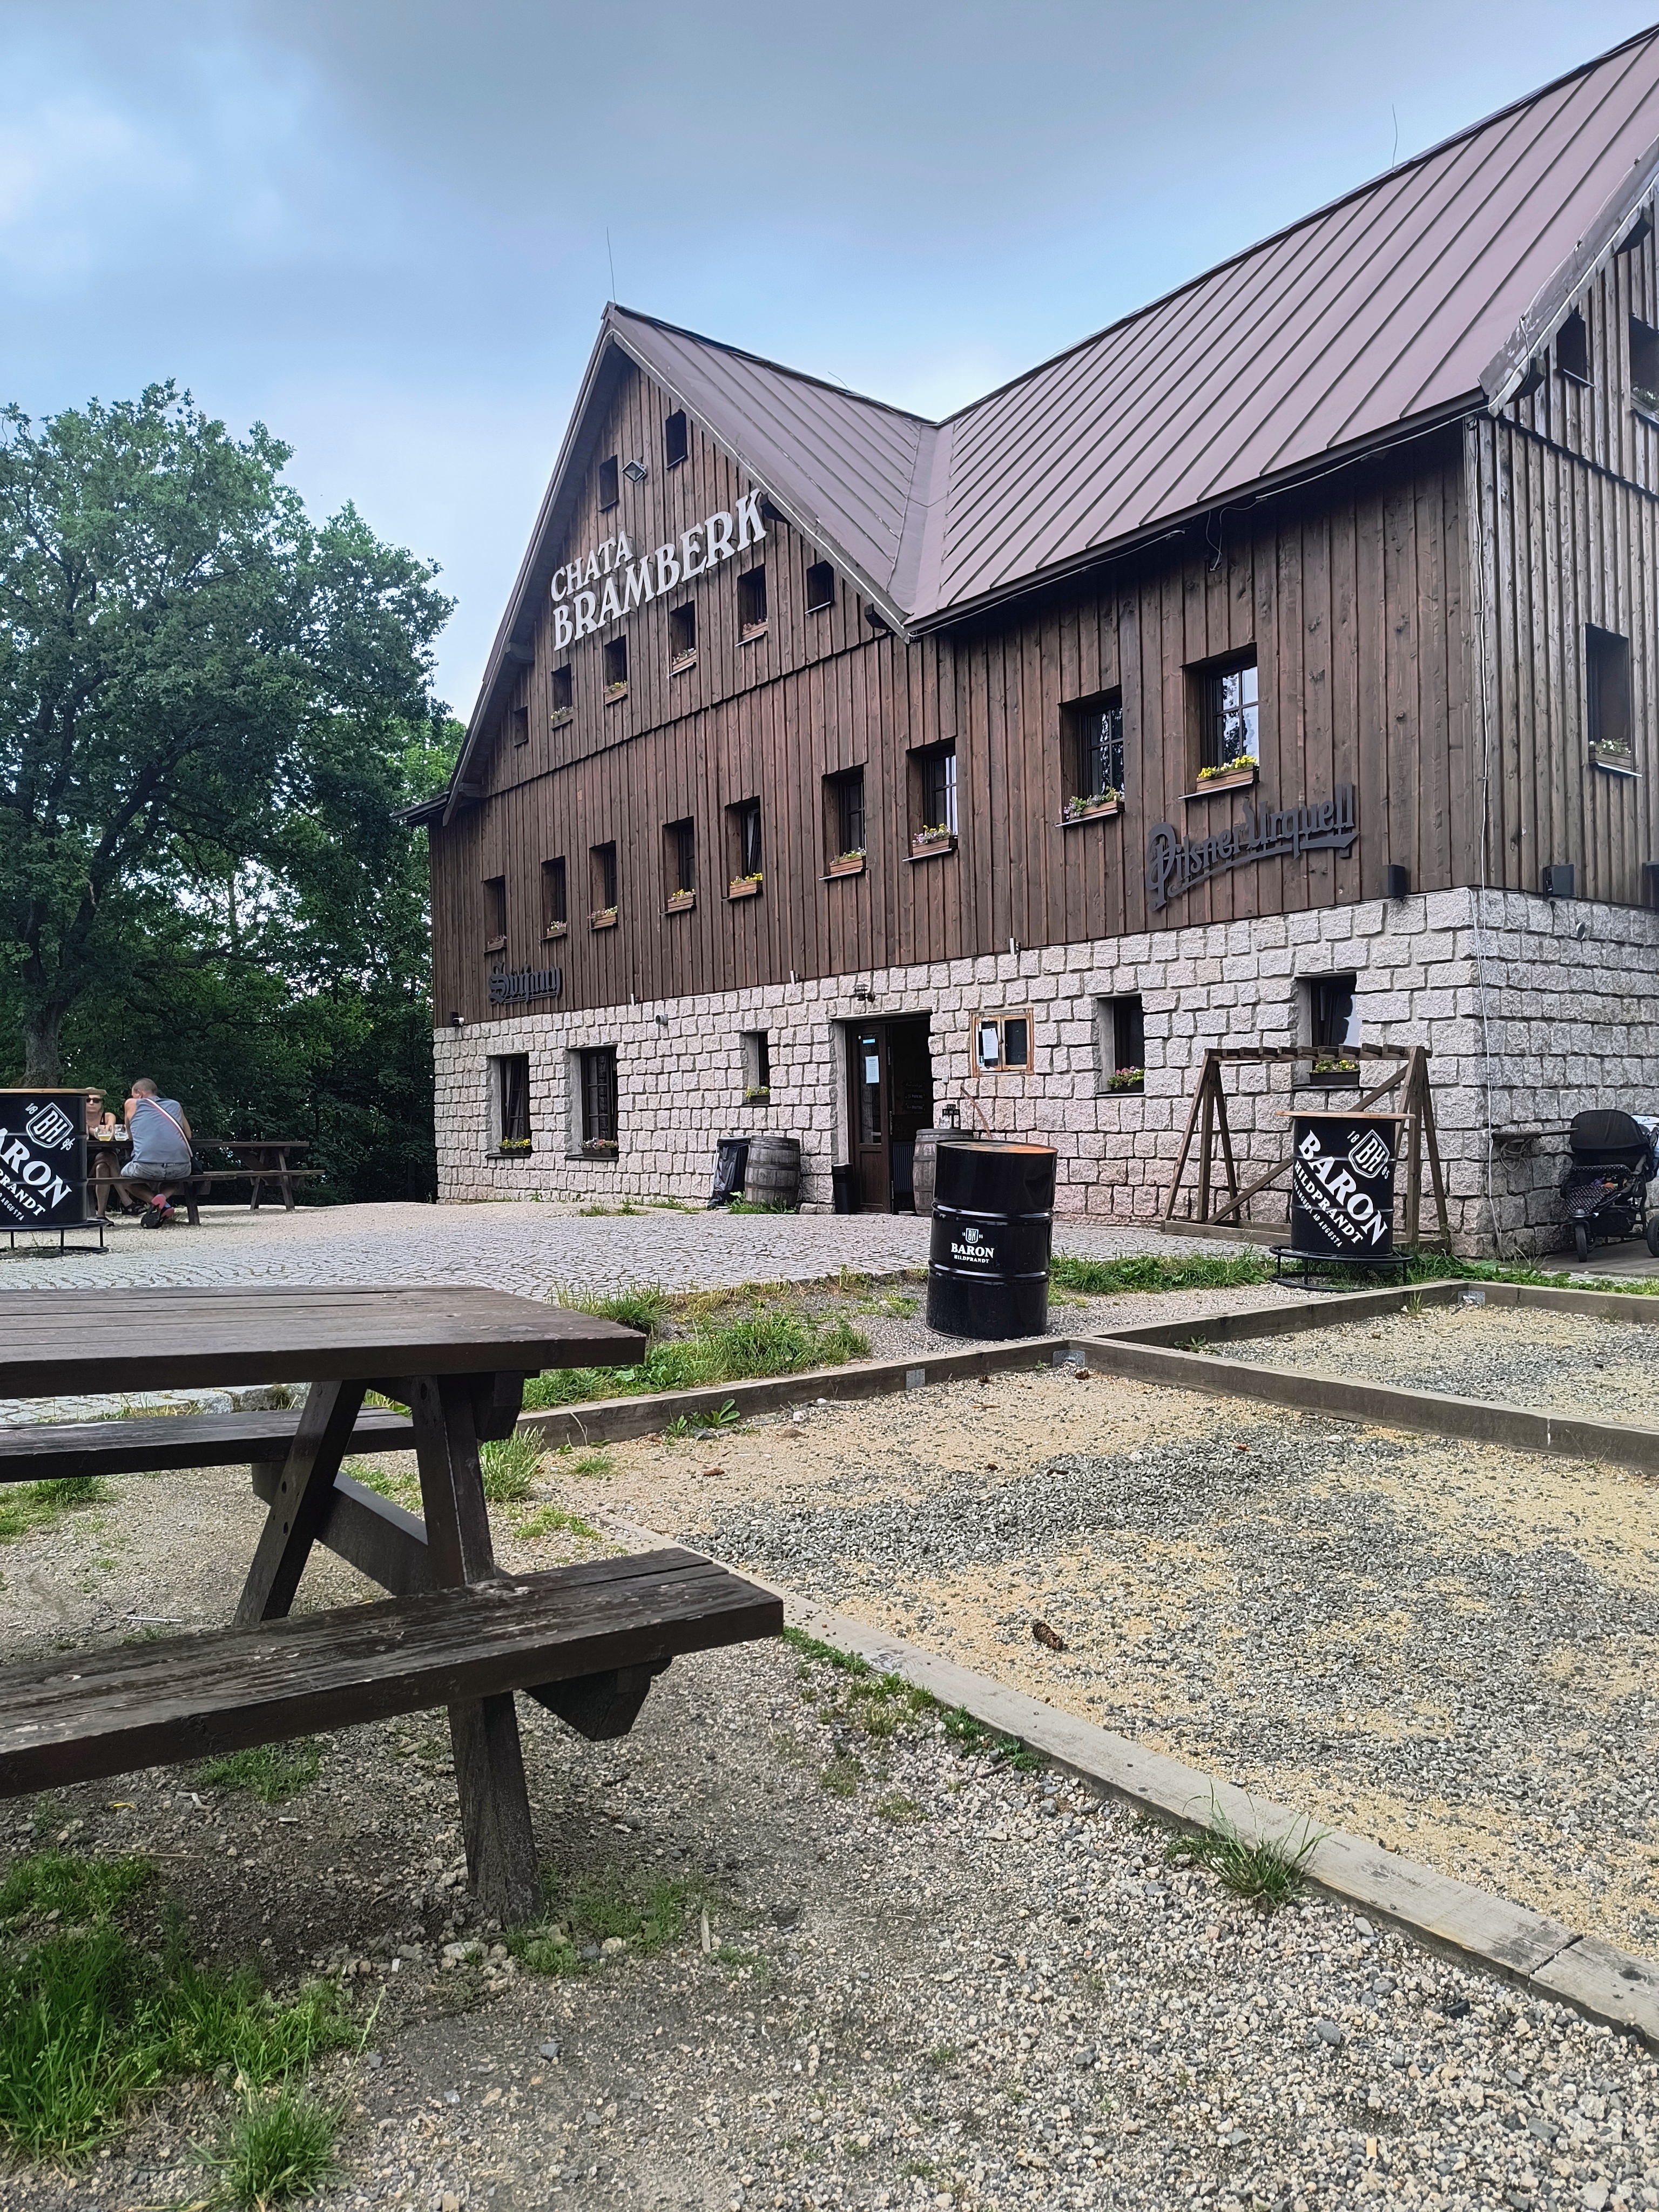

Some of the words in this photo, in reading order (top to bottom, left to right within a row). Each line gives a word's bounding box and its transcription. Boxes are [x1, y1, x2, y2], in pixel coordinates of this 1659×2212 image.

[551, 531, 634, 602] CHATA
[553, 488, 768, 651] BRAMBERK
[1145, 822, 1245, 912] Pilsner
[1243, 784, 1354, 859] Urquell
[33, 1110, 68, 1142] BH
[1347, 1130, 1360, 1143] 18
[1355, 1137, 1386, 1172] BH
[1381, 1166, 1390, 1179] 85
[1294, 1161, 1364, 1244] HILDPRANDT
[1298, 1129, 1388, 1246] BARON
[1, 1197, 24, 1221] AUGUSTA
[950, 1242, 995, 1258] BARON
[968, 1230, 976, 1242] BH
[1318, 1221, 1343, 1247] AUGUSTA
[954, 1254, 990, 1263] HILDPRANDT
